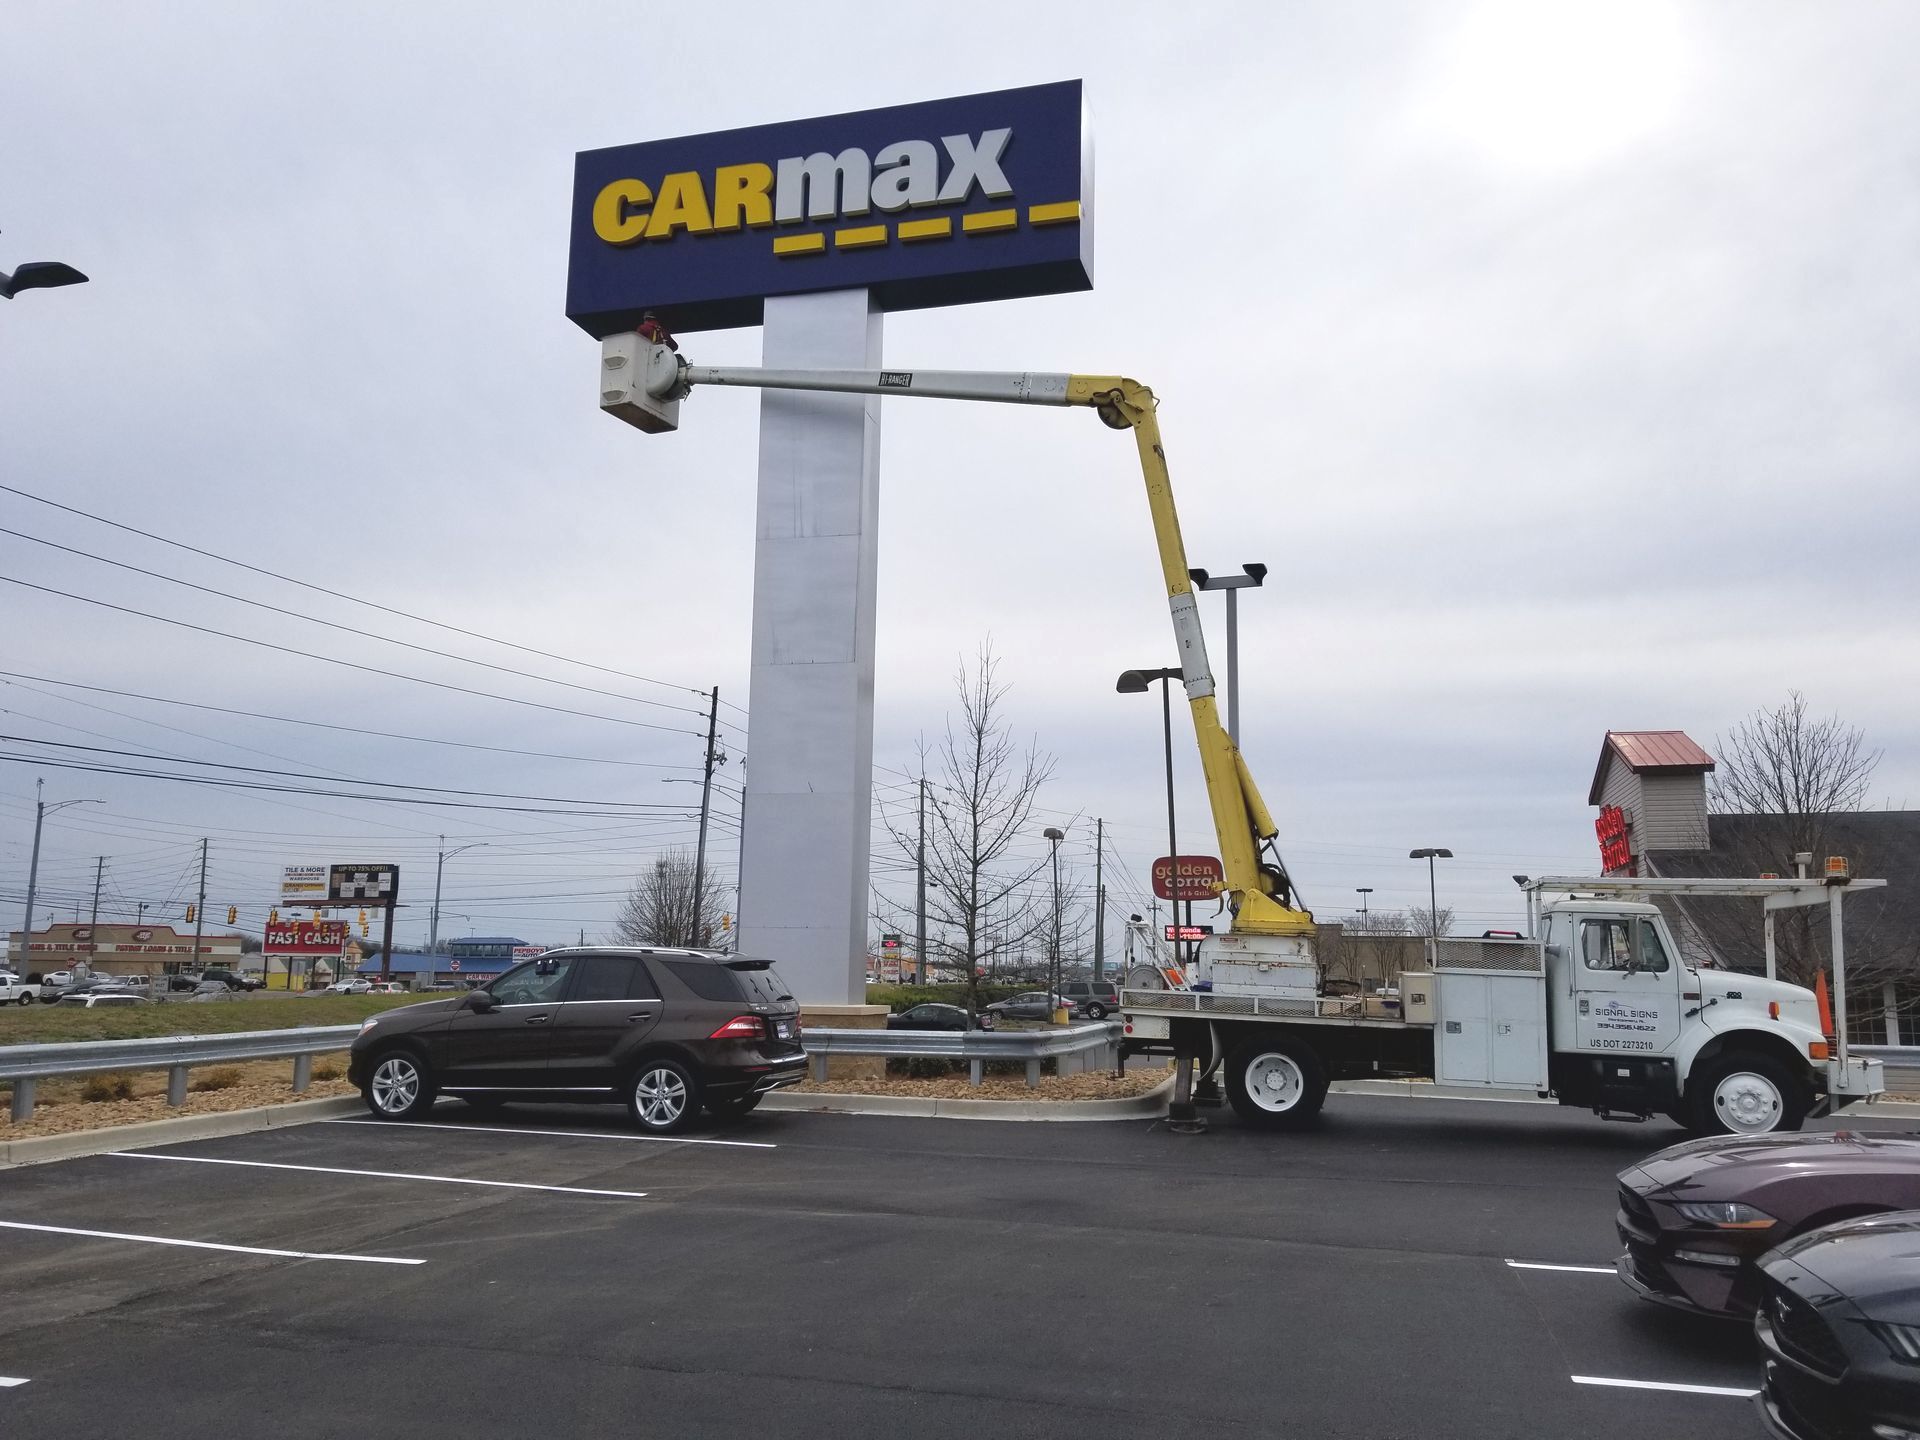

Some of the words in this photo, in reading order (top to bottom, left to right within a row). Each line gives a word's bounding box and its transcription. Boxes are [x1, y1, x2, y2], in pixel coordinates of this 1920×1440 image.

[592, 127, 1014, 246] CARmax
[880, 373, 911, 387] HI-RANGER
[268, 931, 300, 945] FAST
[304, 931, 340, 945] CASH
[1595, 1008, 1629, 1017] SIGNAL
[1630, 1010, 1659, 1019] SIGNS
[1590, 1038, 1602, 1048] US
[1603, 1039, 1621, 1048] DOT
[1622, 1040, 1654, 1050] 2273210
